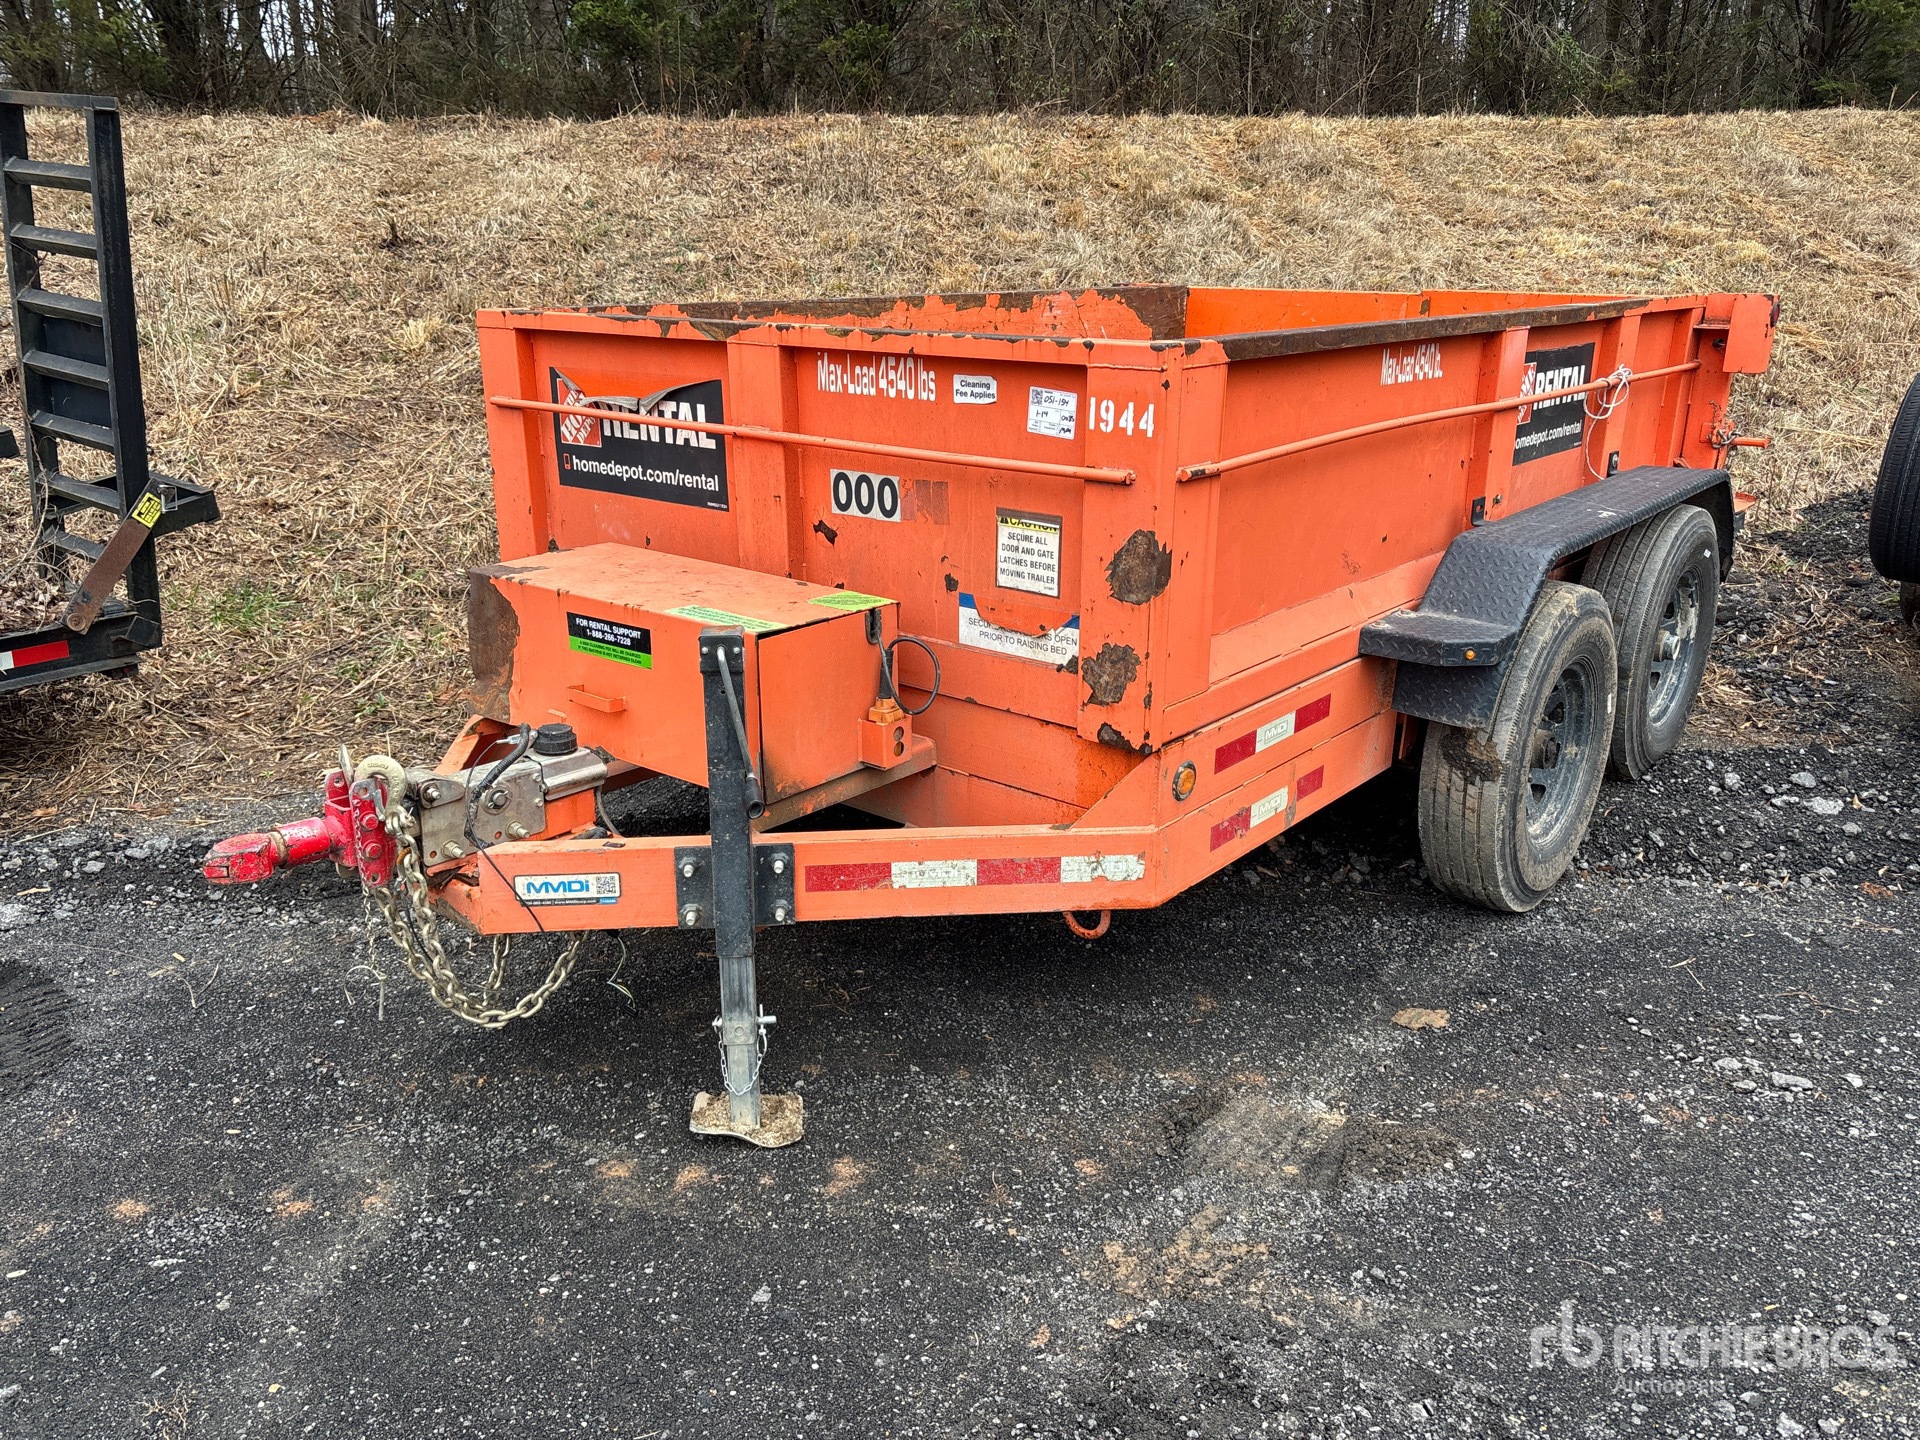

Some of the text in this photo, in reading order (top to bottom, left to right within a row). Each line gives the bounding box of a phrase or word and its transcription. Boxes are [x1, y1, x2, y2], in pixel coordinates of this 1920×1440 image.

[817, 351, 936, 401] Max-Load 4540 lbs
[1380, 345, 1416, 386] Max-Load
[1415, 343, 1435, 381] 4540
[955, 389, 996, 400] Fee Applies
[960, 379, 991, 391] Cleaning
[1533, 365, 1586, 411] RENTAL
[600, 400, 717, 450] RENTAL
[1089, 396, 1155, 438] 1944
[1515, 419, 1583, 449] omedepot.com/rental
[572, 454, 719, 491] homedepot.com/rental
[833, 471, 898, 519] 000
[1008, 531, 1048, 546] SECURE ALL
[1001, 543, 1055, 560] DOOR AND GATE
[999, 555, 1056, 573] LATCHES BEFORE
[999, 567, 1055, 585] MOVING TRAILER
[575, 617, 642, 640] FOR RENTAL SUPPORT
[1054, 633, 1078, 647] OPEN
[979, 630, 1003, 643] PRIOR
[1004, 635, 1015, 645] TO
[1016, 638, 1049, 652] RAISING
[1050, 645, 1068, 656] BED
[526, 880, 590, 894] MMDi
